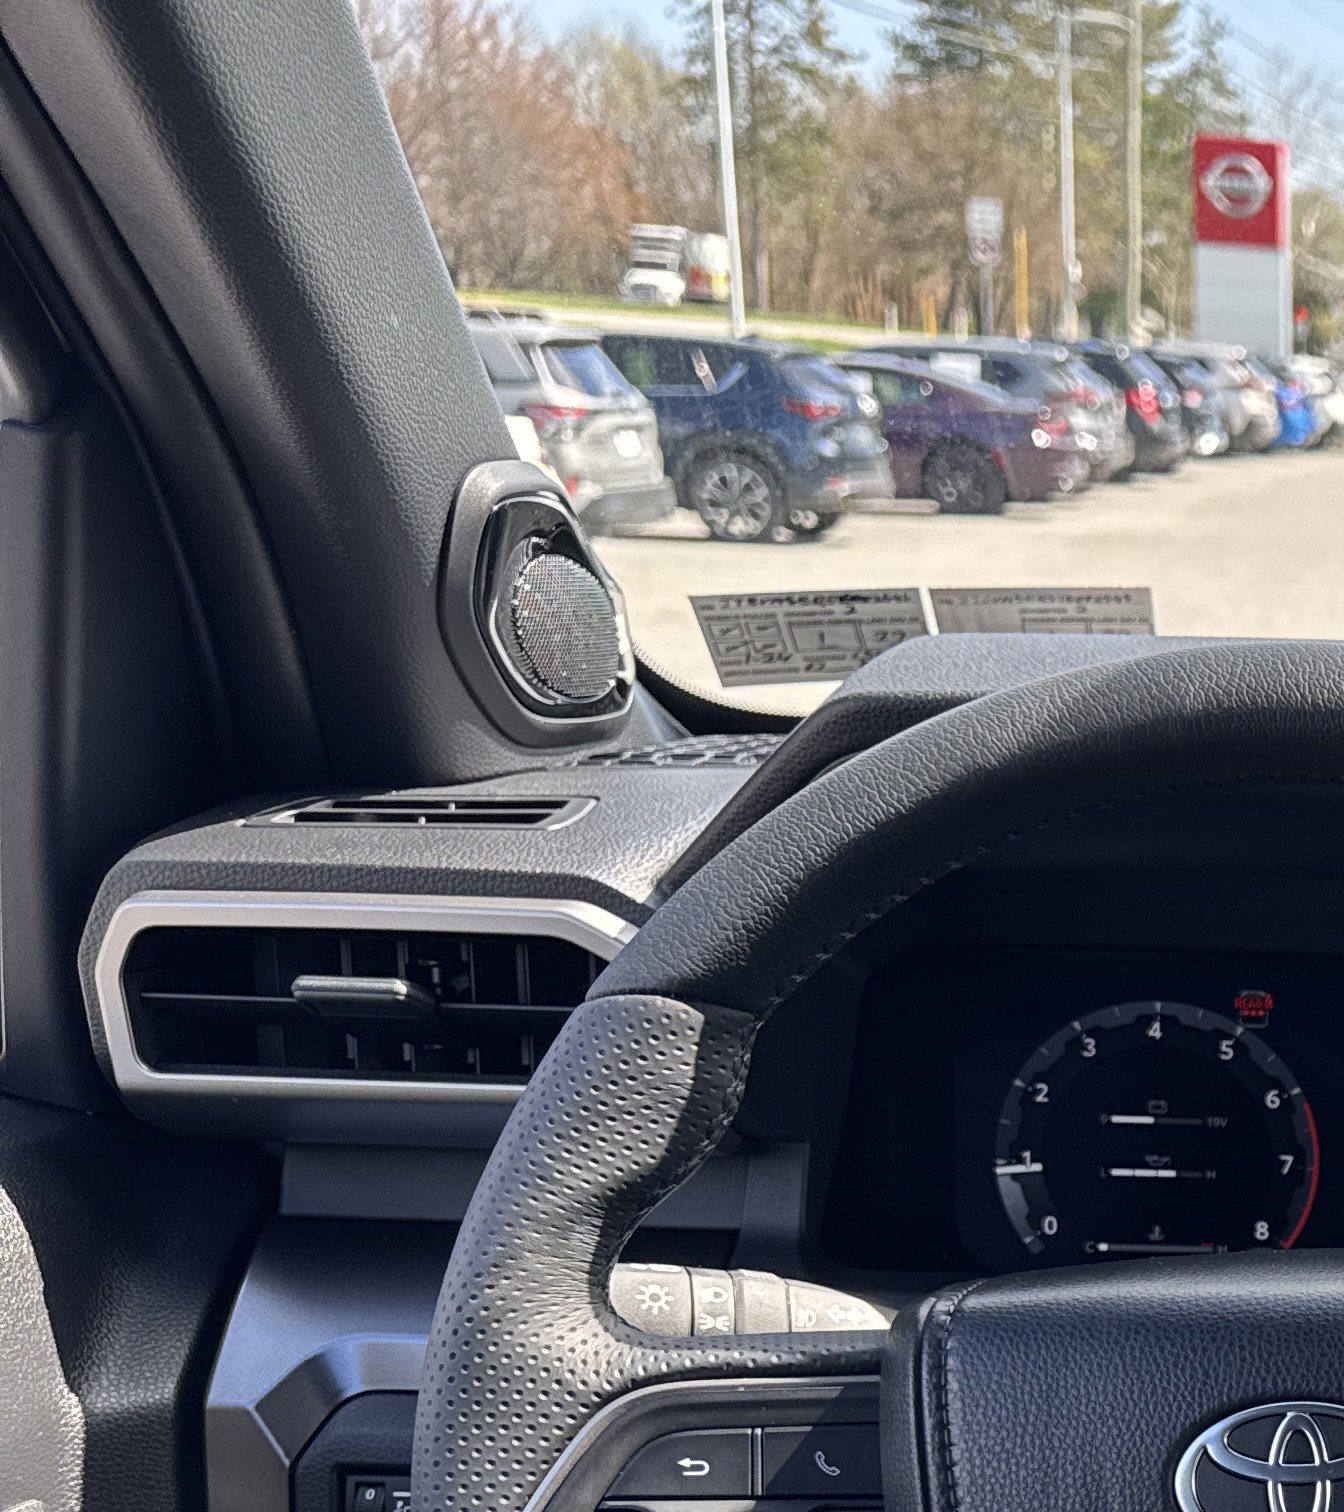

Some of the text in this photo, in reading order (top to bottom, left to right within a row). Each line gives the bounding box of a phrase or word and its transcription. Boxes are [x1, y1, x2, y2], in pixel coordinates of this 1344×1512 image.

[1146, 1022, 1163, 1040] 4
[1080, 1038, 1097, 1057] 3
[1218, 1040, 1235, 1060] 5
[1033, 1083, 1049, 1103] 2
[1264, 1089, 1281, 1110] 6
[1278, 1154, 1294, 1176] 7
[1043, 1215, 1058, 1236] 0
[1253, 1221, 1270, 1241] 8
